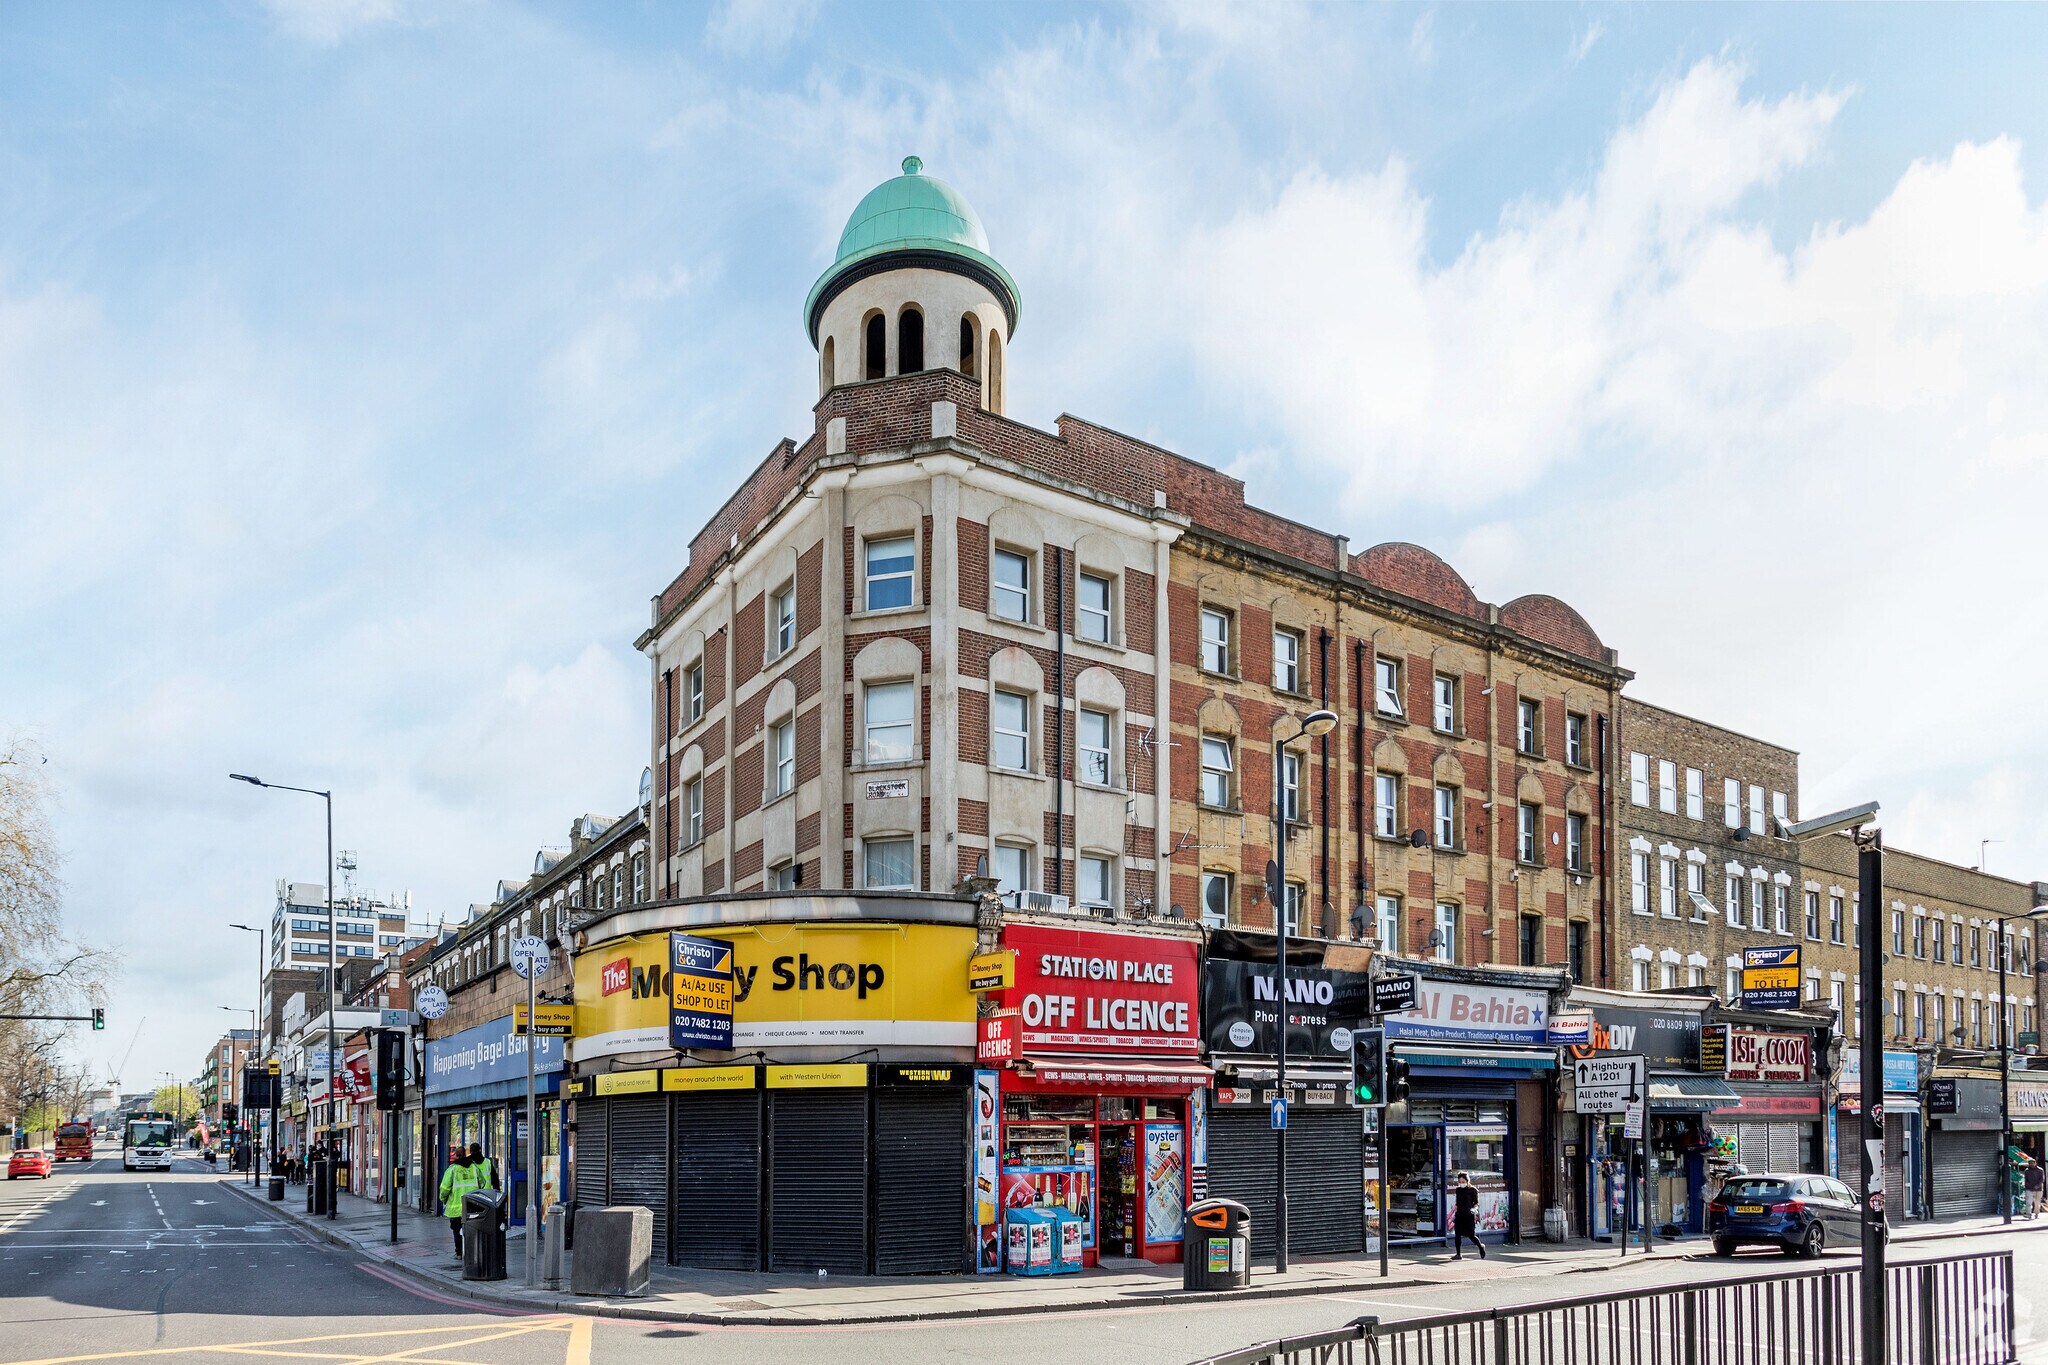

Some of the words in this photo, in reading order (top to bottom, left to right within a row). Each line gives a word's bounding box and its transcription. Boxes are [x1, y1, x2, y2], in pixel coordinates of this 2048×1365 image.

[868, 783, 906, 792] BLACKSTOCK
[520, 938, 542, 948] HOT
[678, 943, 710, 958] Christo
[679, 954, 696, 966] &Co
[516, 962, 548, 976] BAEL
[1042, 954, 1118, 980] STATION
[1124, 961, 1173, 984] PLACE
[604, 968, 628, 992] The
[772, 953, 885, 999] Shop
[989, 977, 998, 986] gold
[681, 978, 706, 992] A1/A2
[708, 982, 726, 994] USE
[1376, 982, 1411, 994] NANO
[1754, 980, 1767, 988] TO
[1771, 979, 1788, 988] LET
[424, 988, 441, 996] HOT
[1254, 976, 1334, 1005] NANO
[676, 994, 700, 1007] SHOP
[703, 997, 714, 1008] TO
[716, 1000, 730, 1010] LET
[421, 1006, 446, 1018] BAGEL
[1023, 994, 1076, 1028] OFF
[1087, 997, 1188, 1032] LICENCE
[1450, 994, 1530, 1025] Bahia
[675, 1016, 690, 1026] 020
[691, 1017, 710, 1028] 7482
[712, 1020, 730, 1030] 1203
[1255, 1010, 1278, 1022] Pho
[1290, 1014, 1327, 1026] express
[988, 1021, 1002, 1040] OFF
[1654, 1019, 1665, 1028] 020
[1667, 1020, 1682, 1030] 8809
[1685, 1021, 1698, 1031] 9191
[682, 1032, 724, 1040] www.christo.co.uk
[1022, 1034, 1035, 1042] NEWS
[1079, 1036, 1108, 1044] WINES/SPIRITS
[1400, 1028, 1414, 1036] Halal
[1414, 1029, 1430, 1037] Meat,
[1431, 1030, 1444, 1038] Dairy
[1446, 1031, 1466, 1039] Product,
[1468, 1032, 1494, 1040] Traditional
[1494, 1032, 1510, 1040] Cakes
[1515, 1034, 1534, 1042] Grocery
[978, 1038, 1012, 1058] LICENCE
[1766, 1038, 1806, 1065] COOK
[433, 1047, 475, 1076] Happening
[478, 1036, 505, 1066] Bagel
[1665, 1056, 1681, 1064] Gardening
[1591, 1062, 1633, 1072] Highbury
[674, 1076, 693, 1084] money
[728, 1074, 744, 1082] world
[1044, 1072, 1058, 1080] NEWS
[1060, 1072, 1086, 1080] MAGAZINES
[1106, 1074, 1122, 1082] SPIRITS
[1125, 1074, 1144, 1082] TOBACCO
[1148, 1075, 1179, 1084] CONFECTIONERY
[1182, 1076, 1191, 1084] SOFT
[1192, 1076, 1206, 1084] DRINKS
[1729, 1070, 1760, 1079] PRINTERS
[1764, 1070, 1801, 1080] STATIONERS
[1290, 1082, 1308, 1090] Phone
[1219, 1092, 1232, 1100] VAPE
[1236, 1092, 1250, 1100] SHOP
[1266, 1092, 1293, 1100] REPIR
[1308, 1092, 1333, 1100] BUY-BACK
[1579, 1091, 1591, 1099] All
[1594, 1090, 1618, 1098] other
[1584, 1101, 1613, 1109] routes
[1148, 1130, 1180, 1144] oyster
